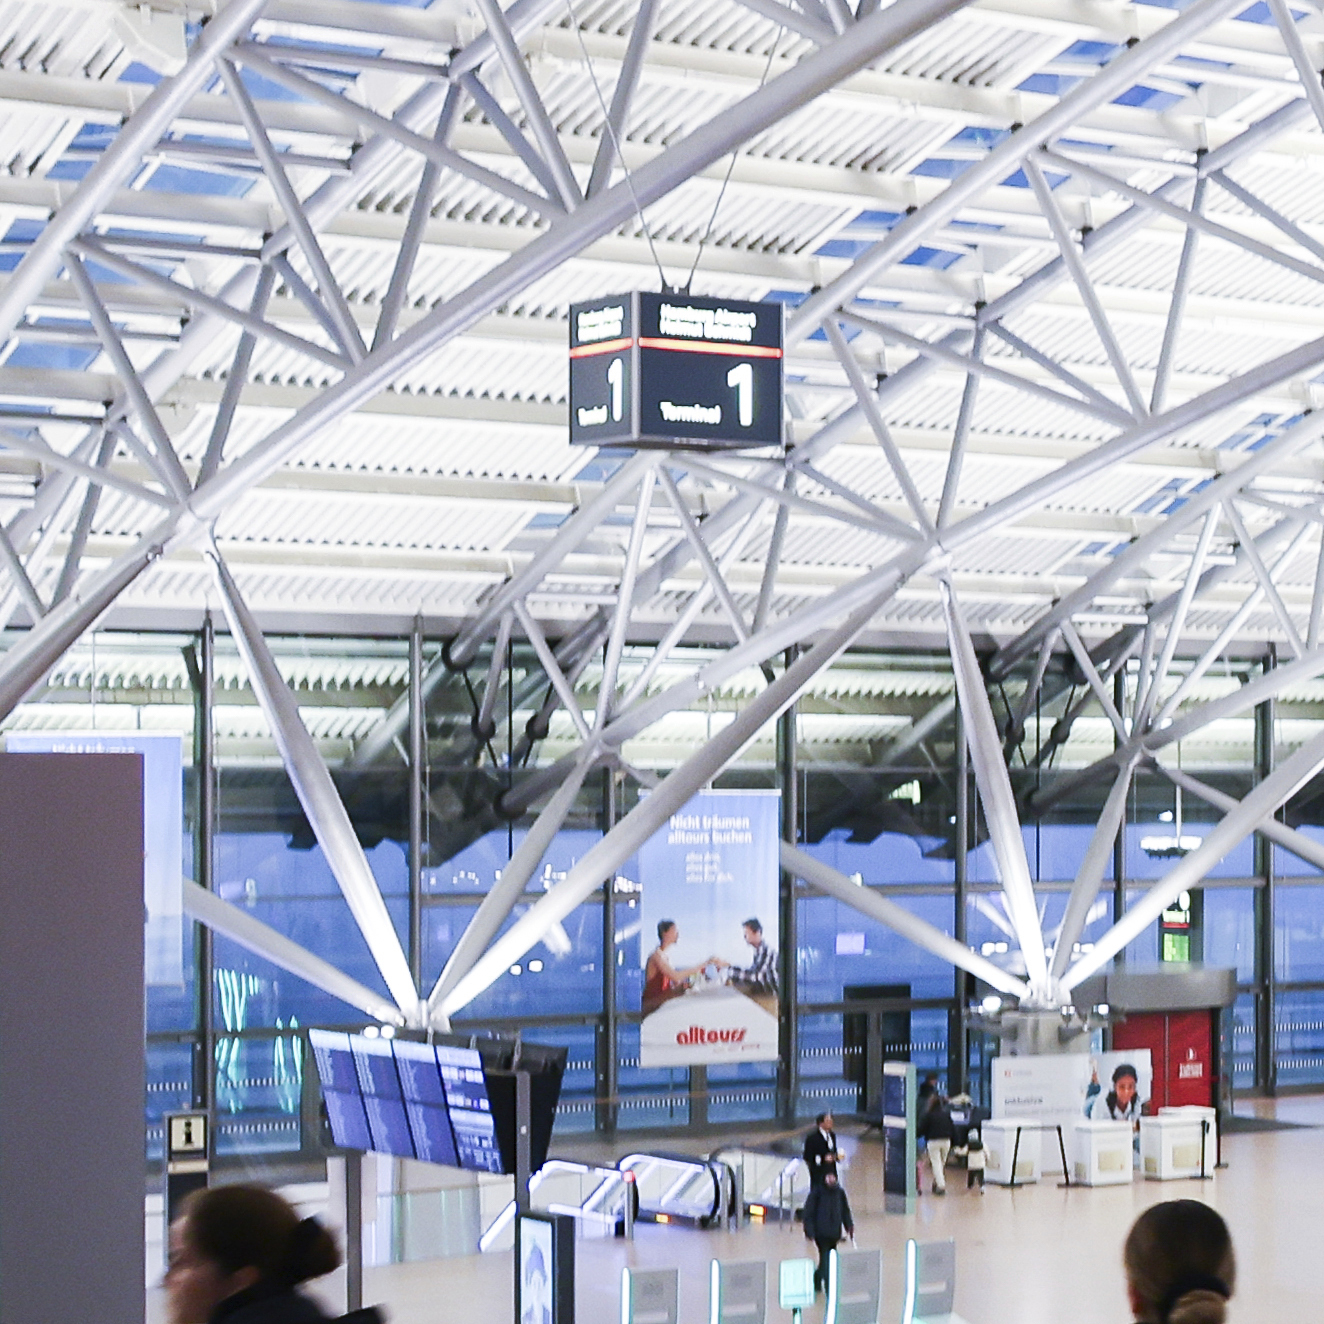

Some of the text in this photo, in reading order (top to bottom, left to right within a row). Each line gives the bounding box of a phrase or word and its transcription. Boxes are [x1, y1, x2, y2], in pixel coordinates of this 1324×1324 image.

[727, 363, 753, 427] 1
[669, 814, 699, 829] Nicht
[667, 829, 752, 845] alltours buchen
[676, 1024, 747, 1046] alltours
